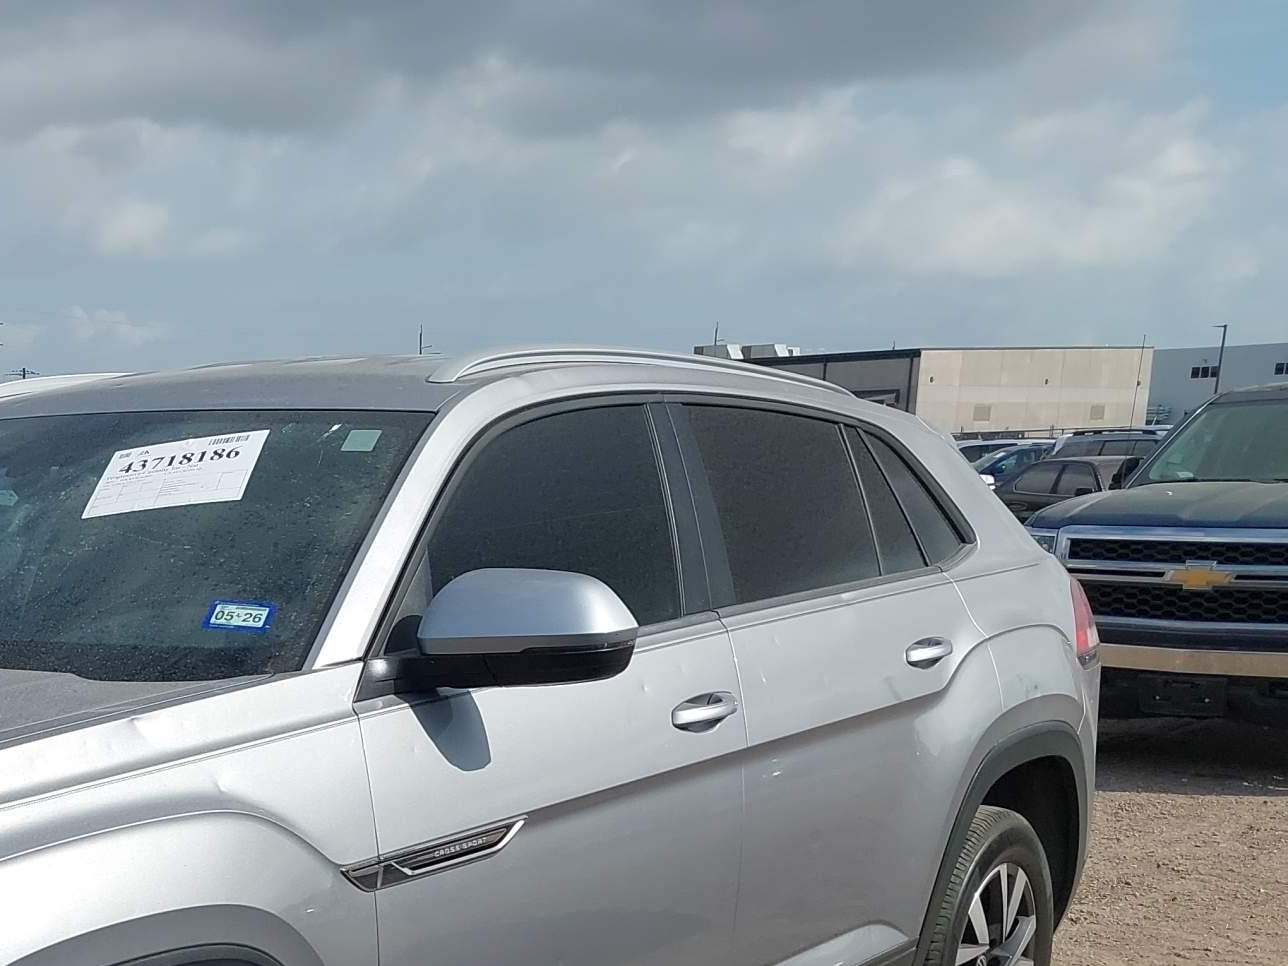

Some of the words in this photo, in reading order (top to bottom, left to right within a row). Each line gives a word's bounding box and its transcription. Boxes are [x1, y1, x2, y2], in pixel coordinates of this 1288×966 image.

[119, 446, 242, 474] 43718186
[214, 610, 235, 621] 05
[241, 612, 263, 624] 26
[433, 845, 460, 857] CROSS
[461, 837, 487, 850] SPORT
